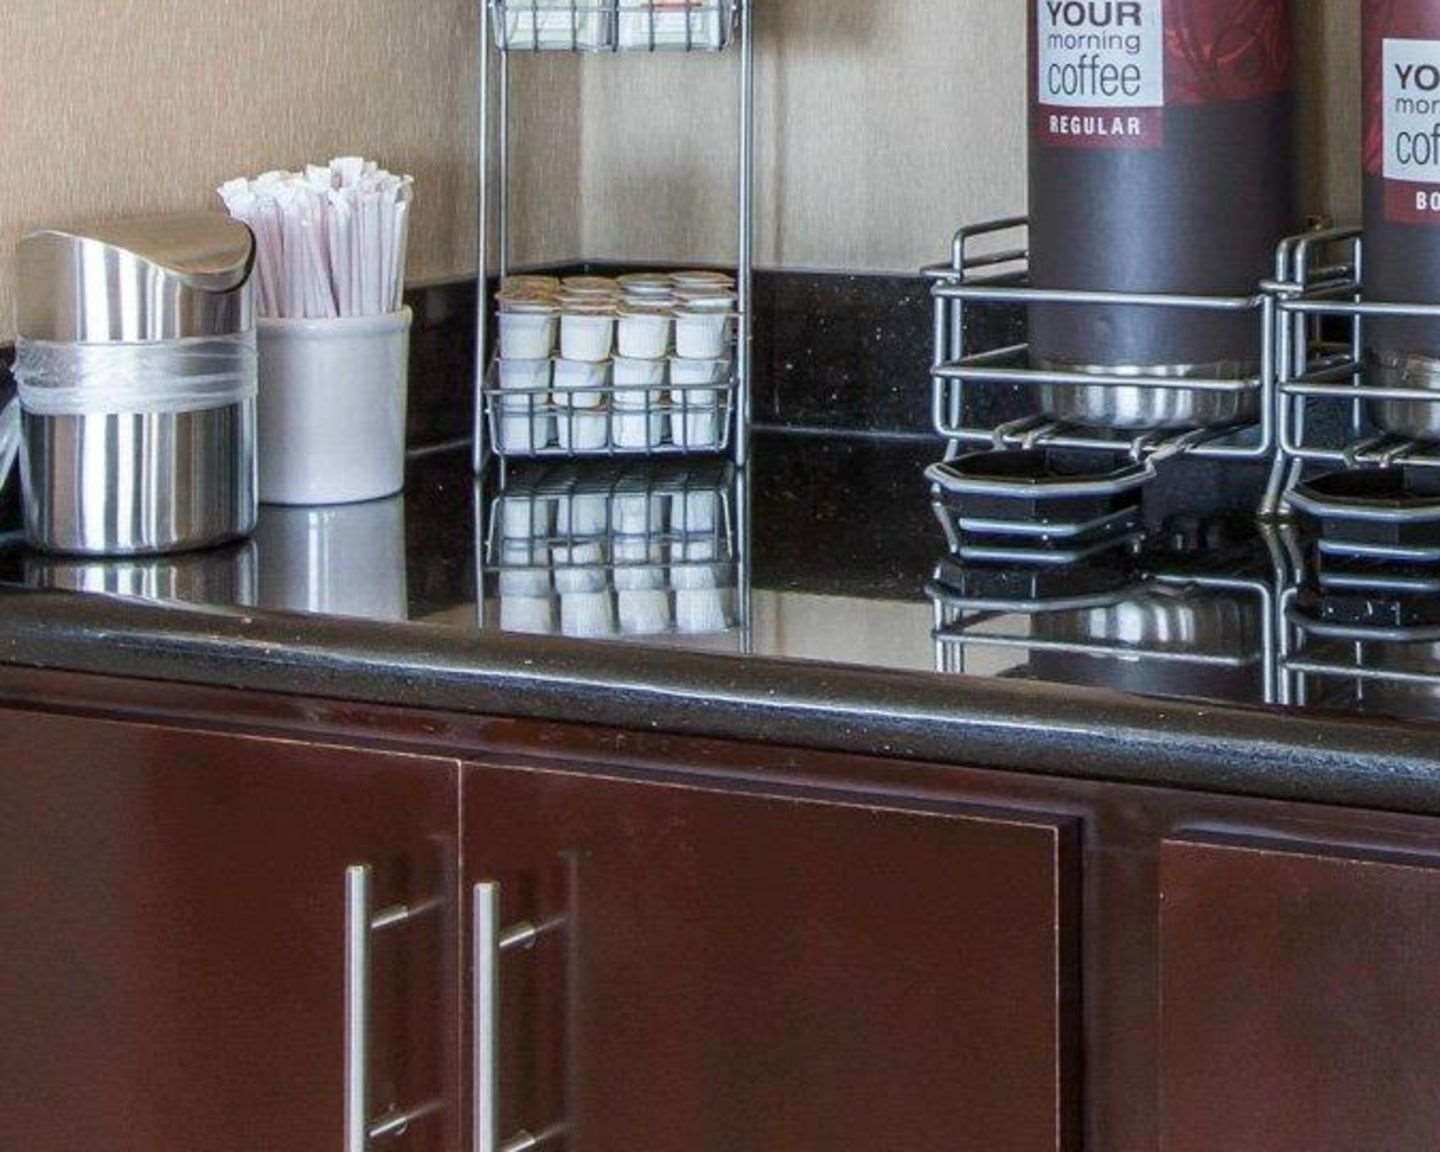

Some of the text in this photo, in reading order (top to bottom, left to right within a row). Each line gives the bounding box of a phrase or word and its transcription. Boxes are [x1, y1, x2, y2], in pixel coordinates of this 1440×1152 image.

[1046, 1, 1142, 27] YOUR
[1048, 32, 1141, 55] morning
[1048, 53, 1142, 97] coffee
[1049, 114, 1141, 136] REGULAR
